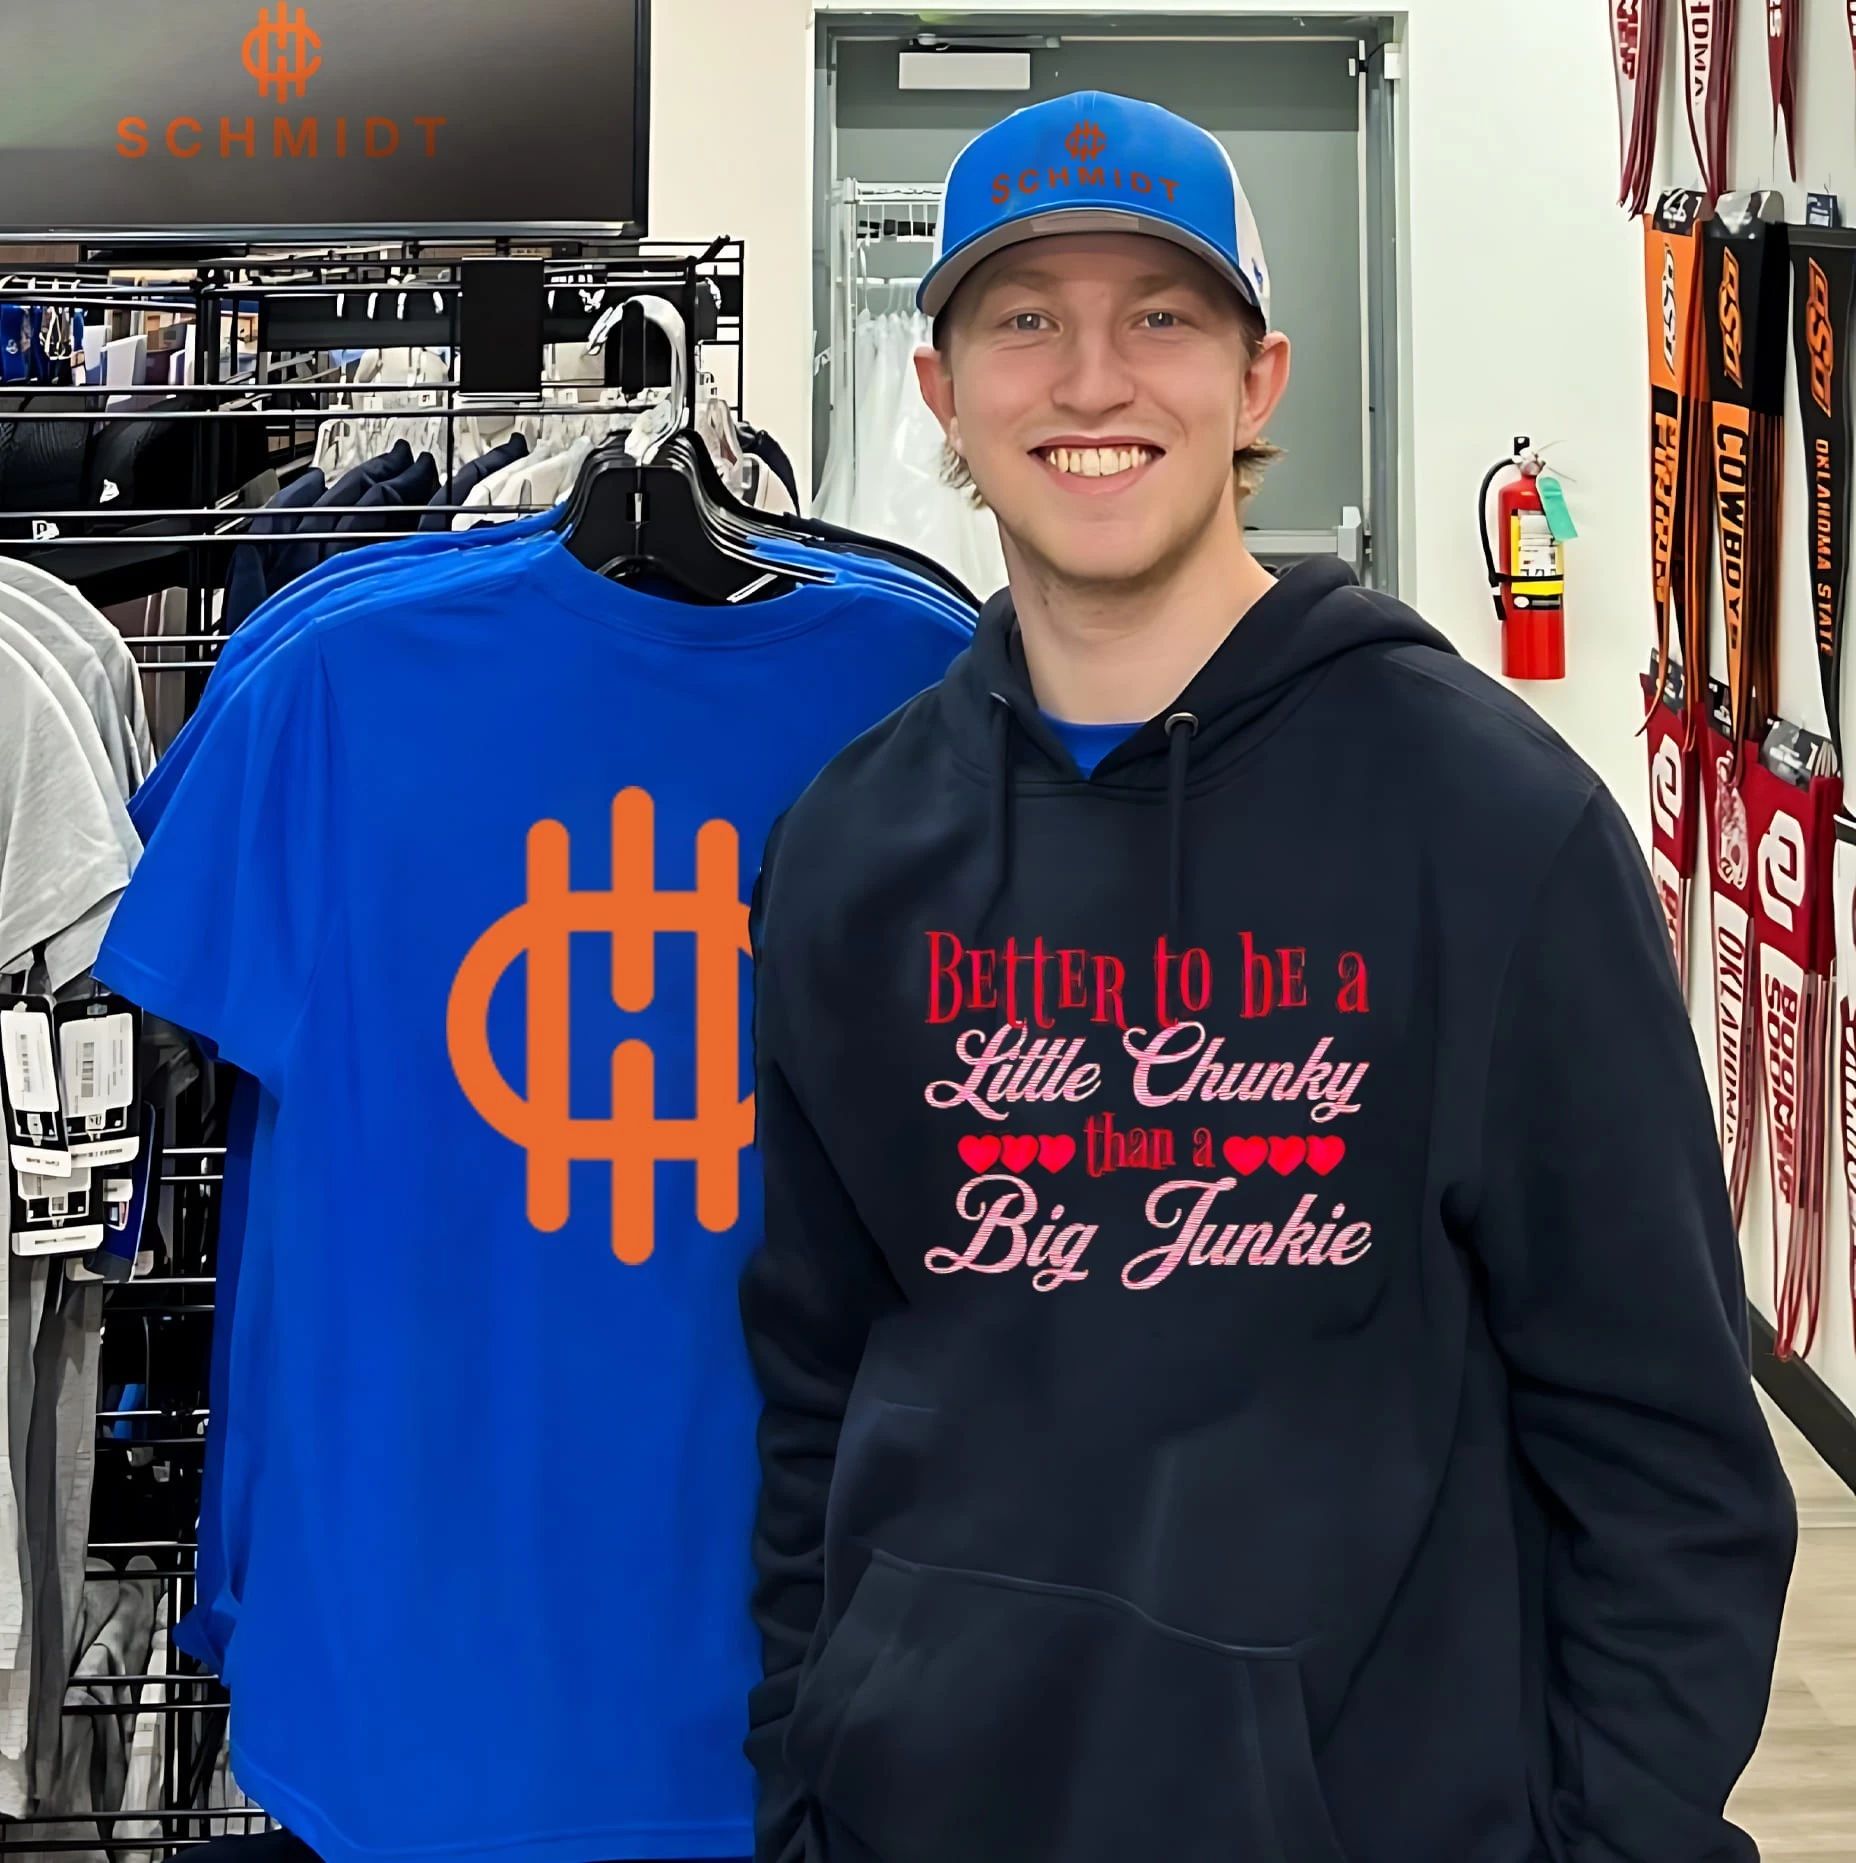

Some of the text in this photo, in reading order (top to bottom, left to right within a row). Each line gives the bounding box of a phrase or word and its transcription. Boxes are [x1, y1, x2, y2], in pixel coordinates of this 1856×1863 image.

[116, 116, 447, 158] SCHMIDT
[992, 166, 1180, 204] SCHMIDT
[1815, 438, 1832, 570] OKLAHOMA
[1153, 934, 1213, 1028] to
[1336, 951, 1370, 1013] a
[924, 1021, 1370, 1123] Little Chunky
[1084, 1112, 1215, 1178] than a
[924, 1174, 1372, 1292] Big Junkie
